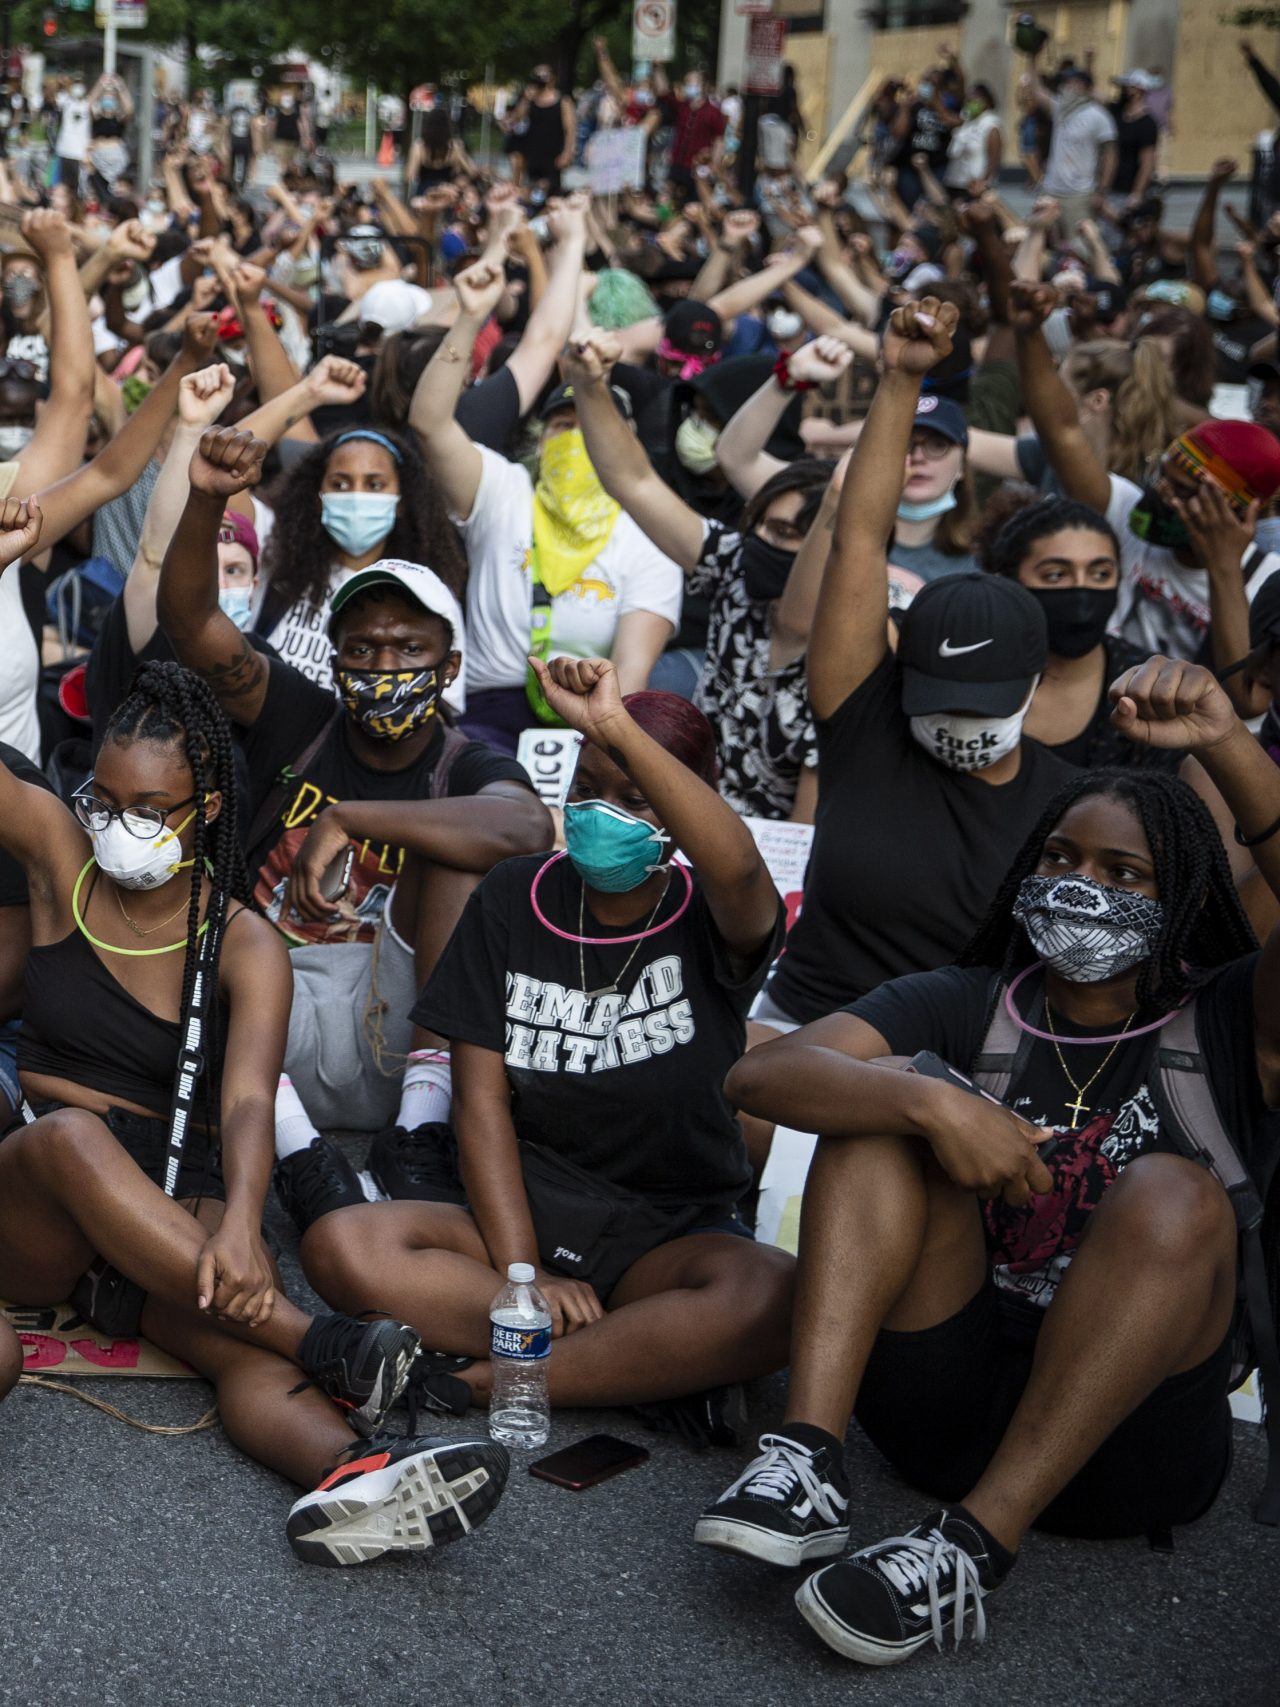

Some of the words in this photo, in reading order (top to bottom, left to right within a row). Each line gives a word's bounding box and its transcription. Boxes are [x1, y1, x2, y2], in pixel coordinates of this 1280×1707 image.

[287, 603, 323, 632] HIG
[935, 727, 999, 751] fuck
[935, 745, 991, 764] this
[534, 740, 564, 808] tice
[505, 999, 696, 1074] EATNESS
[170, 1107, 187, 1148] PUMA
[164, 1156, 179, 1197] PUMA
[492, 1328, 522, 1342] DEER
[492, 1336, 523, 1353] PARK
